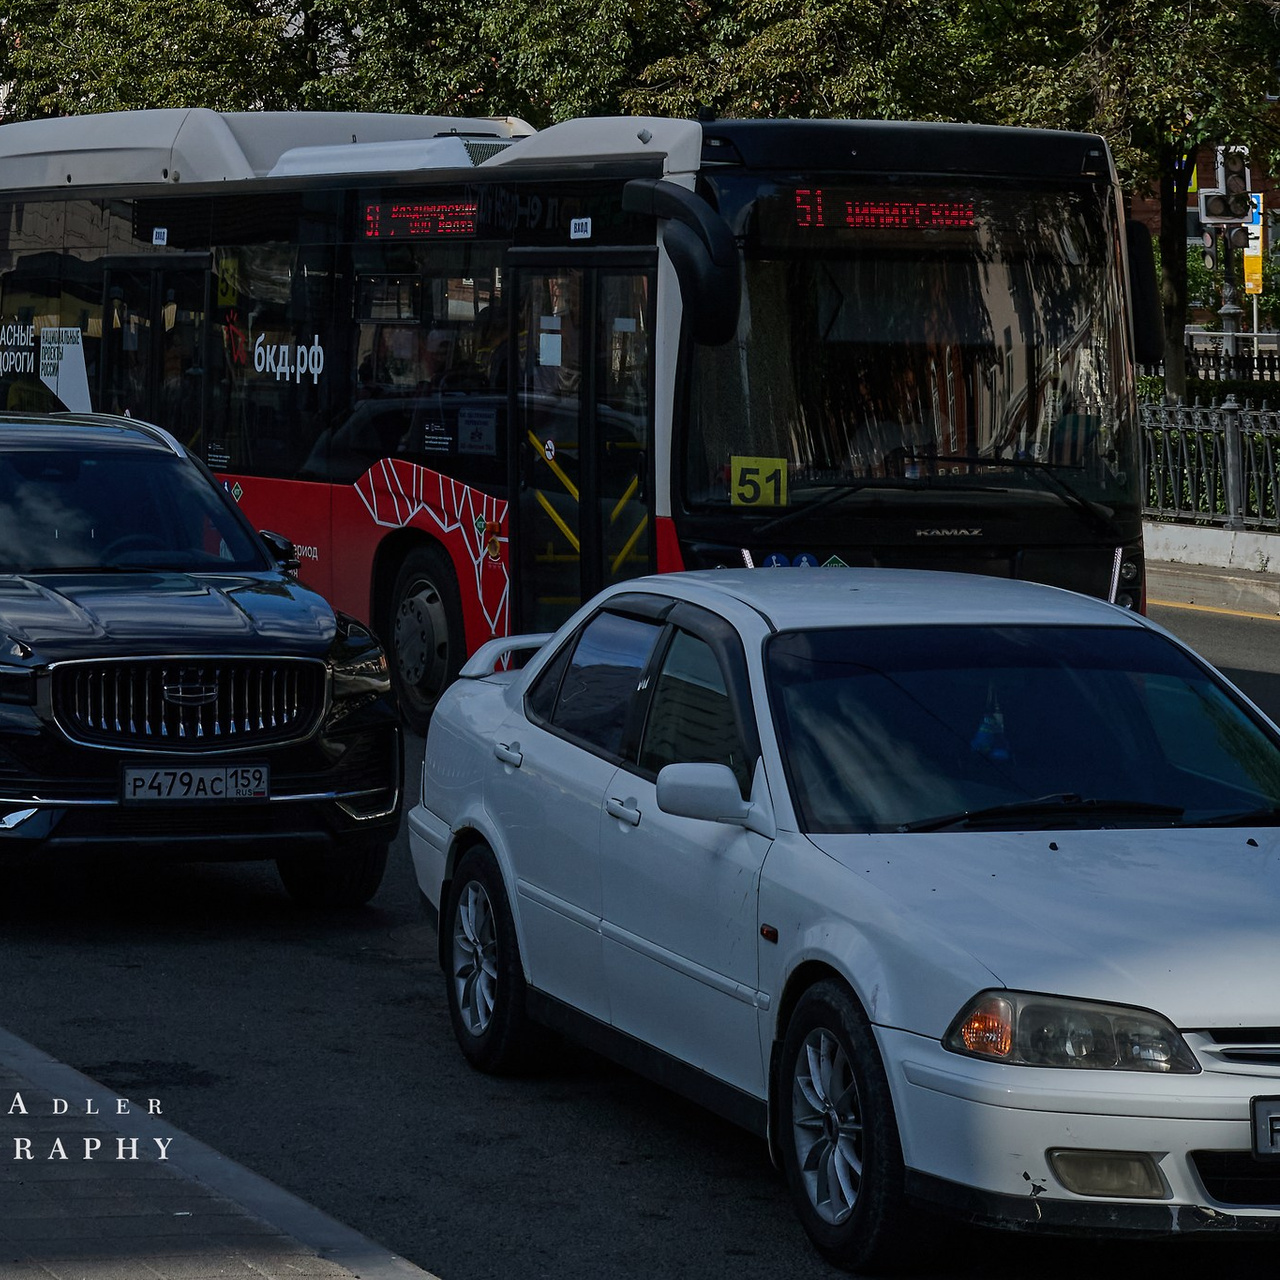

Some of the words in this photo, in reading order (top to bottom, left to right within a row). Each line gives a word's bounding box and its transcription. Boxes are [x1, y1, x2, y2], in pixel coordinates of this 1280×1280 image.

[366, 205, 379, 236] 51
[795, 190, 825, 227] 51
[573, 221, 588, 235] ВХОД
[253, 332, 325, 385] бкд.рф
[736, 467, 782, 505] 51
[915, 528, 984, 537] KAMAZ
[230, 770, 262, 788] 159
